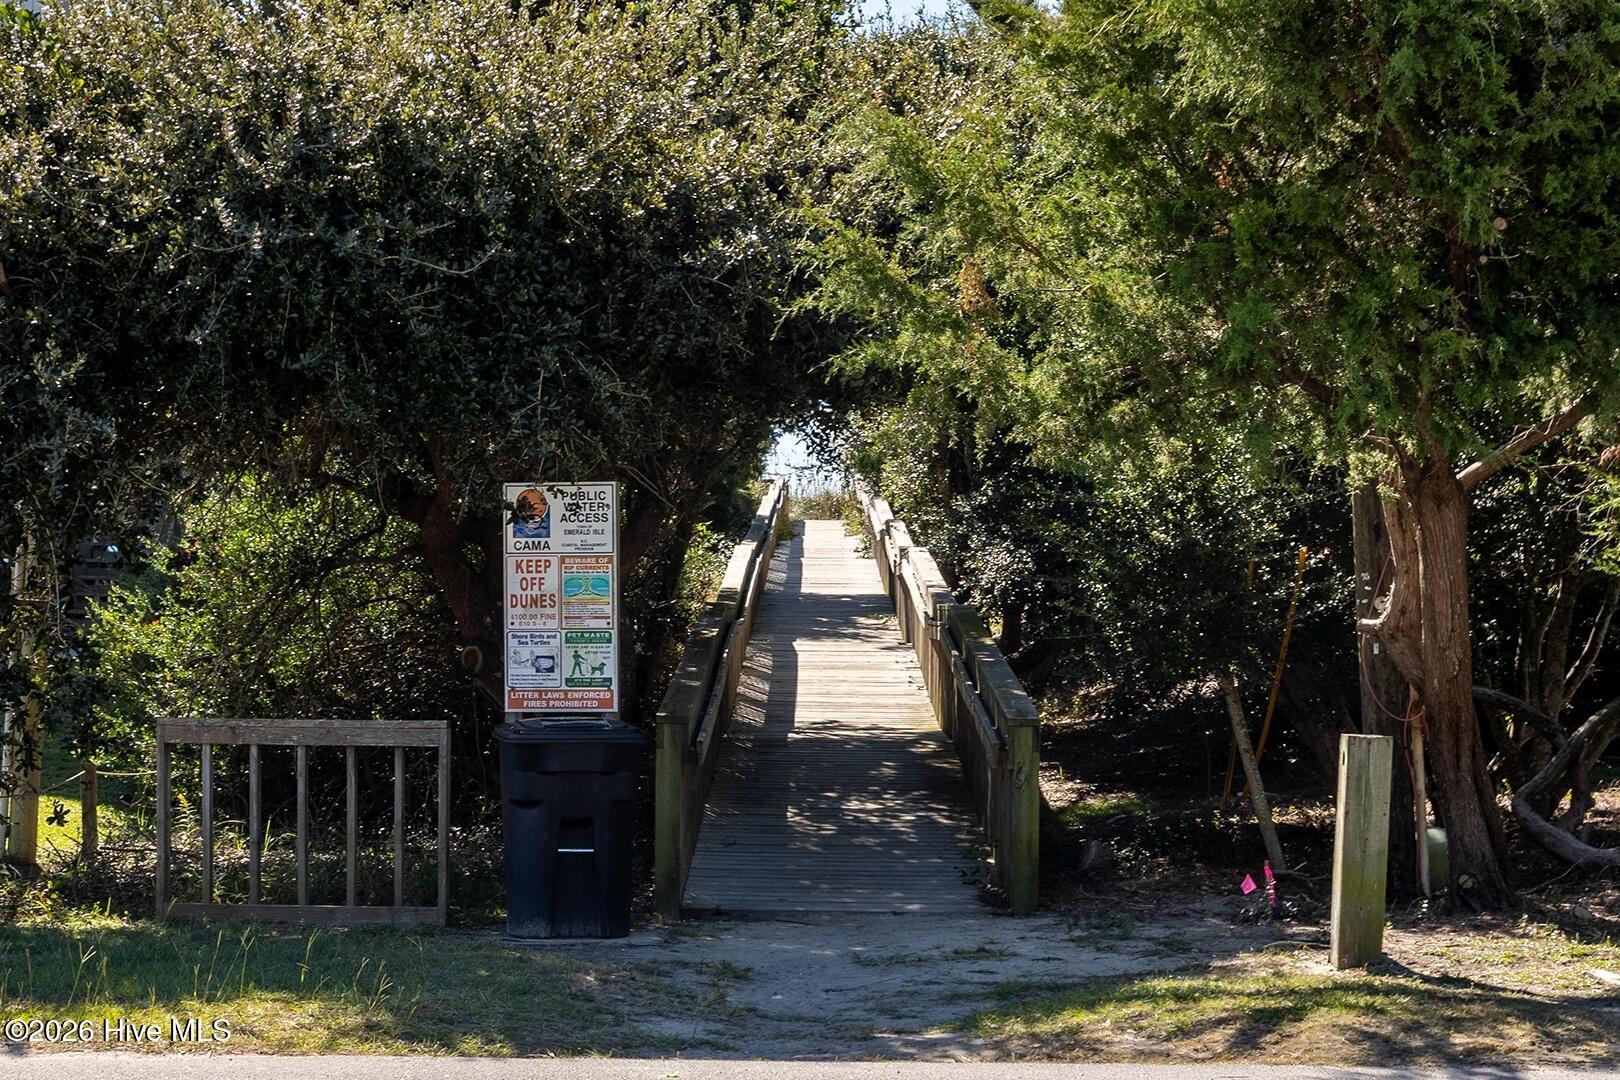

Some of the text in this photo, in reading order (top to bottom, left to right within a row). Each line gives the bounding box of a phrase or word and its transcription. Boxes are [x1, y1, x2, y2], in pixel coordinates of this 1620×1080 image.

[561, 491, 606, 501] PUBLIC
[560, 513, 609, 523] ACCESS
[513, 540, 551, 551] CAMA
[515, 559, 552, 574] KEEP
[519, 576, 545, 592] OFF
[510, 593, 557, 609] DUNES
